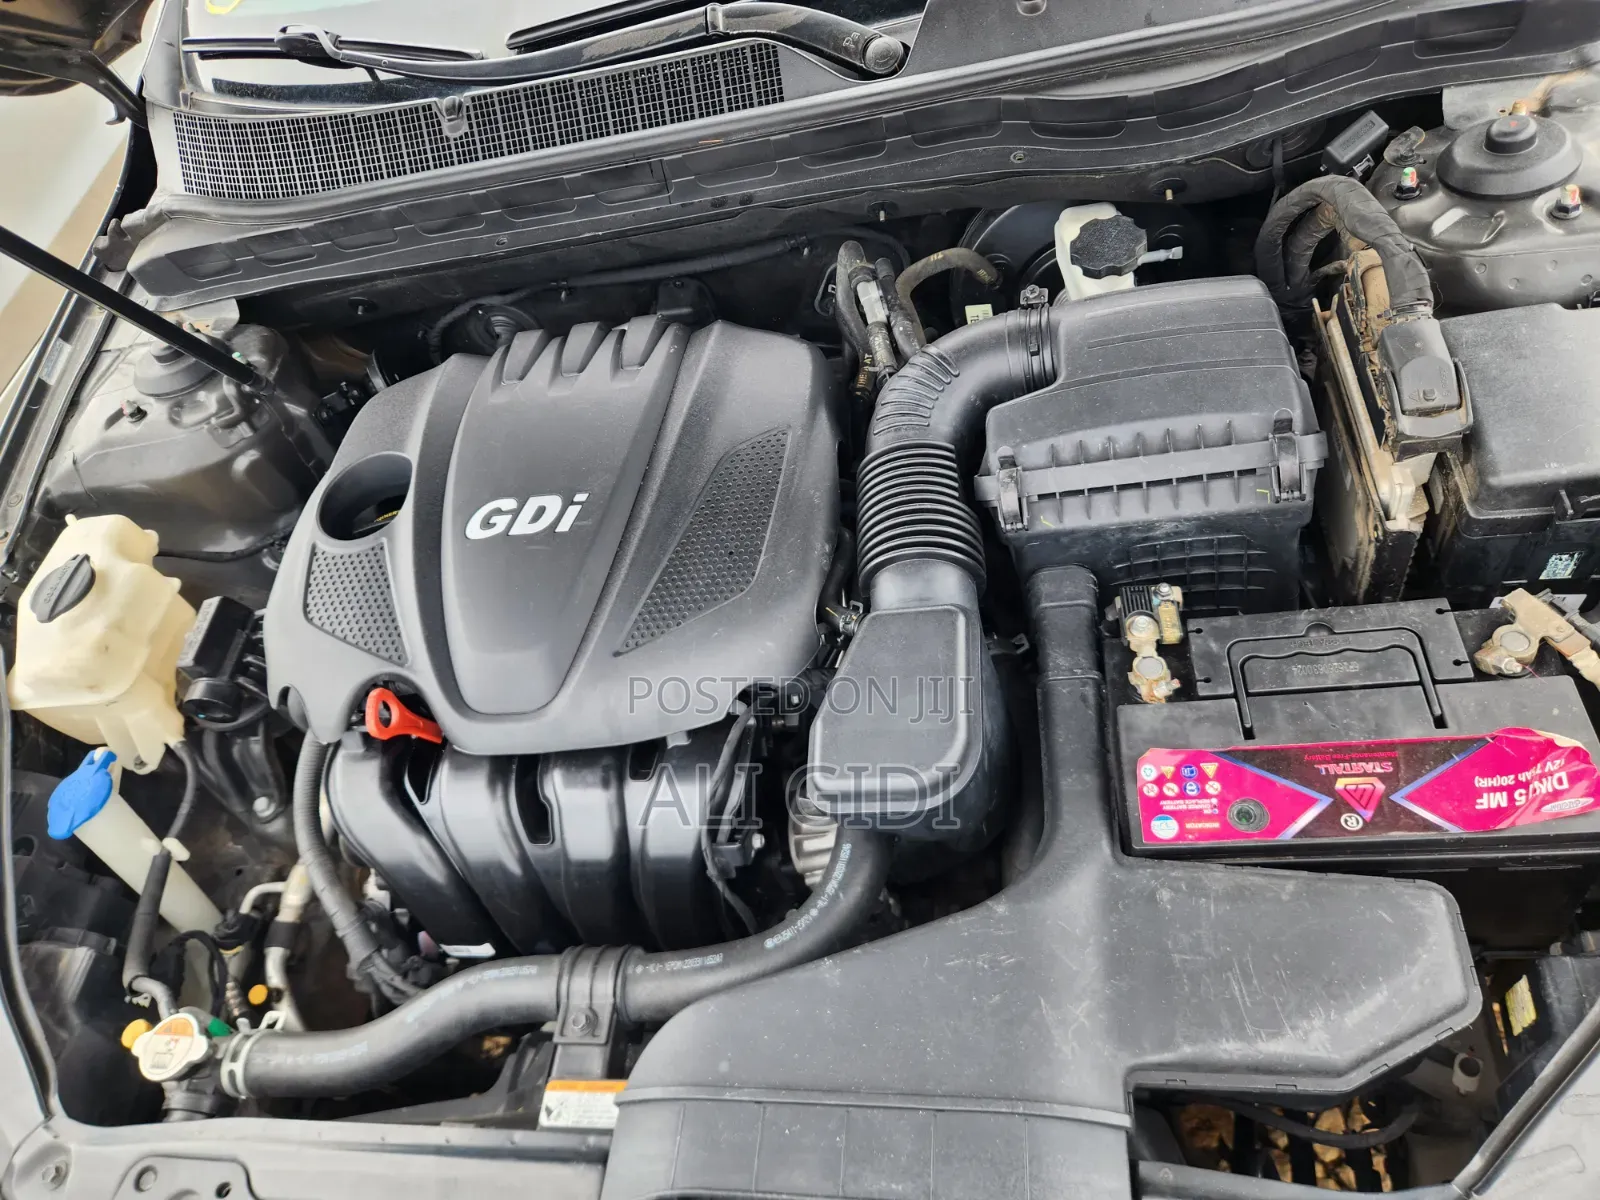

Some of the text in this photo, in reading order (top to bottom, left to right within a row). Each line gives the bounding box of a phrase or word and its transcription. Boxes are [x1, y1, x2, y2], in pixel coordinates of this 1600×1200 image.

[464, 492, 590, 540] GDi
[1474, 775, 1516, 788] 20(HR)
[1475, 791, 1509, 810] MF
